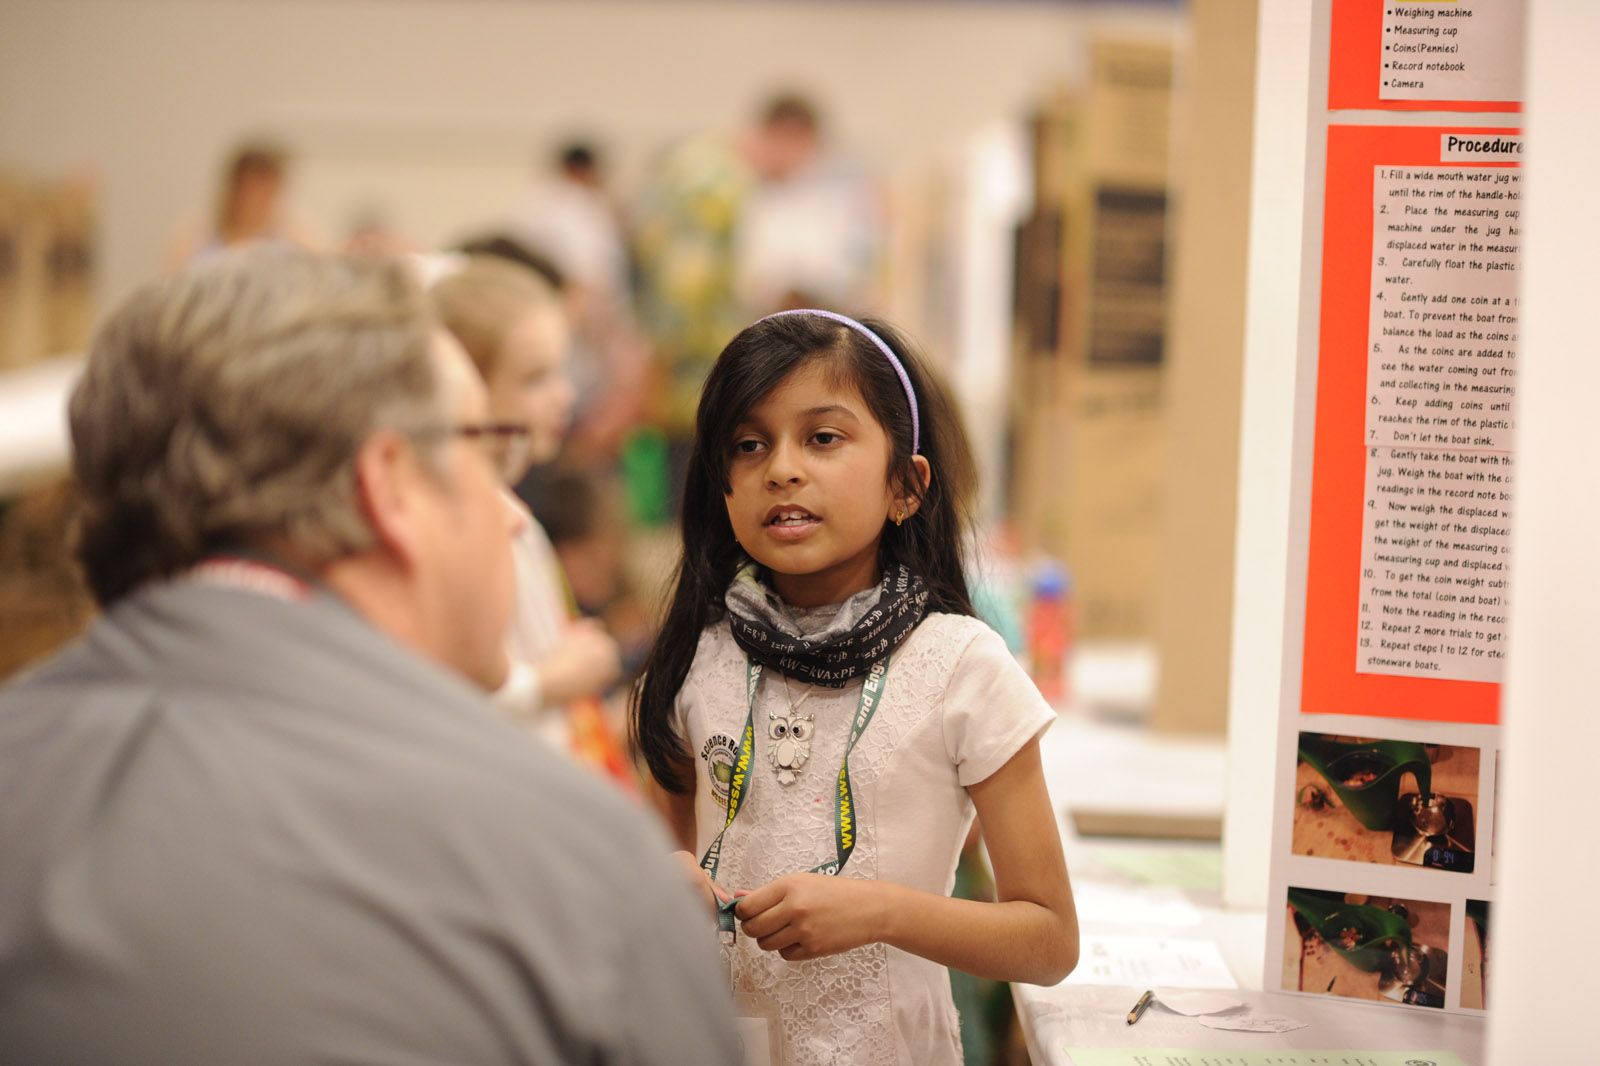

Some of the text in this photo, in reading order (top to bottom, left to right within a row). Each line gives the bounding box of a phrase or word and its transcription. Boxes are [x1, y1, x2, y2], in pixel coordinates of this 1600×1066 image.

[1395, 8, 1472, 19] Weighing machine
[1394, 25, 1458, 38] Measuring cup
[1393, 43, 1458, 53] Coins(Pennies)
[1392, 61, 1465, 71] Record notebook
[1391, 78, 1424, 88] Camera
[1390, 170, 1509, 184] Fill wide mouth water jug
[1389, 188, 1472, 198] until the rim of the
[1405, 205, 1499, 219] Place the measuring
[1388, 223, 1500, 237] machine under the jug
[1387, 240, 1483, 252] displaced water in the
[1402, 258, 1515, 272] Carefully float the plastic
[1385, 276, 1412, 284] water.
[1401, 292, 1428, 304] Gently
[1432, 294, 1447, 303] add
[1471, 296, 1488, 304] coin
[1492, 297, 1501, 305] at
[1384, 309, 1495, 322] boat. To prevent the boat
[1383, 327, 1414, 336] balance
[1419, 328, 1432, 337] the
[1436, 329, 1453, 338] load
[1470, 330, 1483, 340] the
[1486, 332, 1509, 341] coins
[1398, 345, 1409, 354] As
[1414, 346, 1427, 354] the
[1432, 346, 1454, 356] coins
[1477, 349, 1503, 358] added
[1401, 362, 1414, 371] the
[1419, 364, 1444, 372] water
[1448, 366, 1478, 377] coming
[1380, 380, 1468, 392] and collecting in the
[1396, 396, 1510, 411] Keep adding coins until
[1379, 414, 1508, 430] reaches the rim of the plastic
[1394, 430, 1494, 446] Don't let the boat sink.
[1391, 448, 1498, 464] Gently take the boat with
[1377, 466, 1502, 482] jug. Weigh the boat with the
[1377, 485, 1496, 500] readings in the record note
[1389, 501, 1498, 518] Now weigh the displaced
[1375, 520, 1467, 533] get the weight of the
[1374, 536, 1498, 555] the weight of the measuring
[1374, 553, 1502, 571] (measuring cup and displaced
[1385, 570, 1484, 588] To get the coin weight
[1372, 587, 1500, 606] from the total (coin and boat)
[1383, 605, 1483, 622] Note the reading in the
[1382, 622, 1501, 642] Repeat 2 more trials to get
[1381, 639, 1484, 656] Repeat steps to 12 for
[1368, 657, 1440, 670] stoneware boats.
[856, 694, 874, 728] and
[701, 735, 727, 761] Science
[728, 739, 740, 756] Ro
